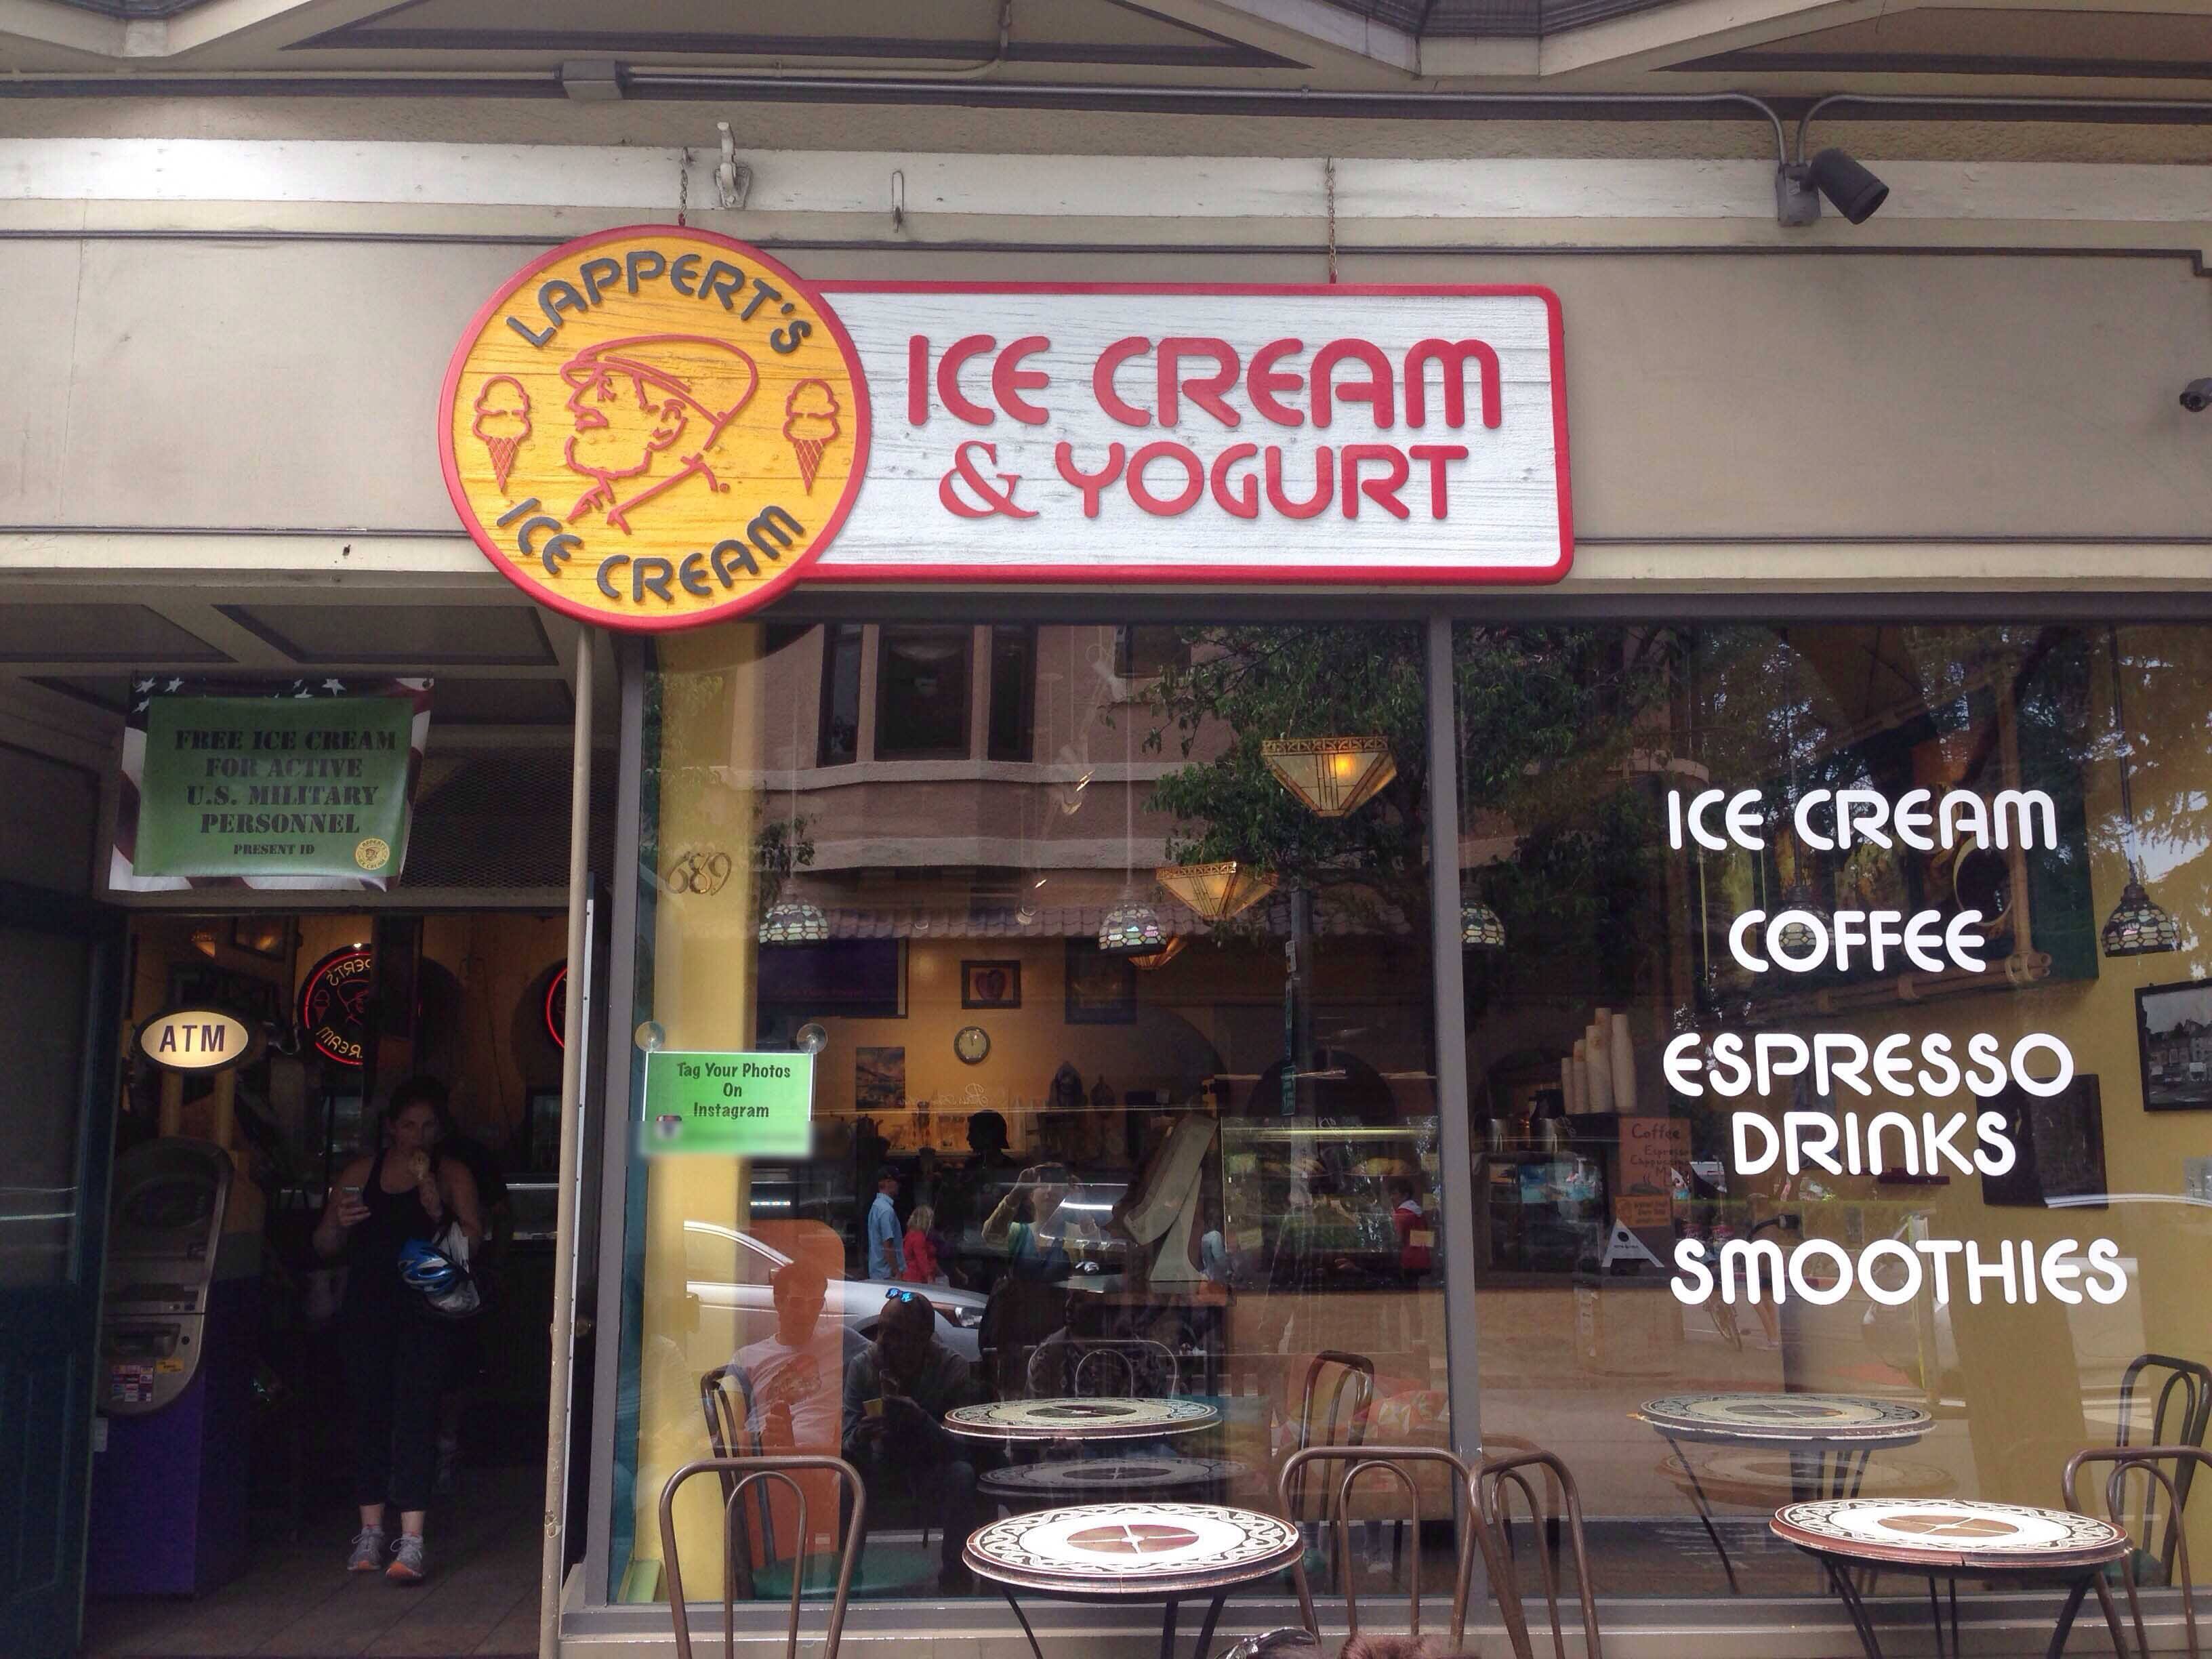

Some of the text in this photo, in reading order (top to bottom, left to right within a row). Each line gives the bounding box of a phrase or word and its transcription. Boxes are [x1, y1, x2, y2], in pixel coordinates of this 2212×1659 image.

[506, 251, 812, 354] LAPPERT'S
[908, 334, 1502, 429] ICE CREAM
[939, 441, 1469, 520] & YOGURT
[497, 497, 804, 602] ICE CREAM
[176, 730, 396, 750] FREE ICE CREAM
[205, 758, 363, 778] FOR ACTIVE
[187, 785, 379, 806] U.S. MILITARY
[201, 813, 360, 834] PERSONNEL
[1667, 788, 2058, 851] ICE CREAM
[234, 844, 315, 855] PRESENT ID
[665, 851, 732, 897] 689
[1728, 909, 1987, 973] COFFEE
[159, 1024, 226, 1052] ATM
[678, 1062, 791, 1080] Tag Your Photos
[1662, 1032, 2075, 1098] ESPRESSO
[722, 1082, 742, 1097] On
[694, 1102, 770, 1120] Instagram
[1631, 1123, 1681, 1139] Coffee
[1732, 1111, 2017, 1176] DRINKS
[1670, 1237, 2129, 1306] SMOOTHIES
